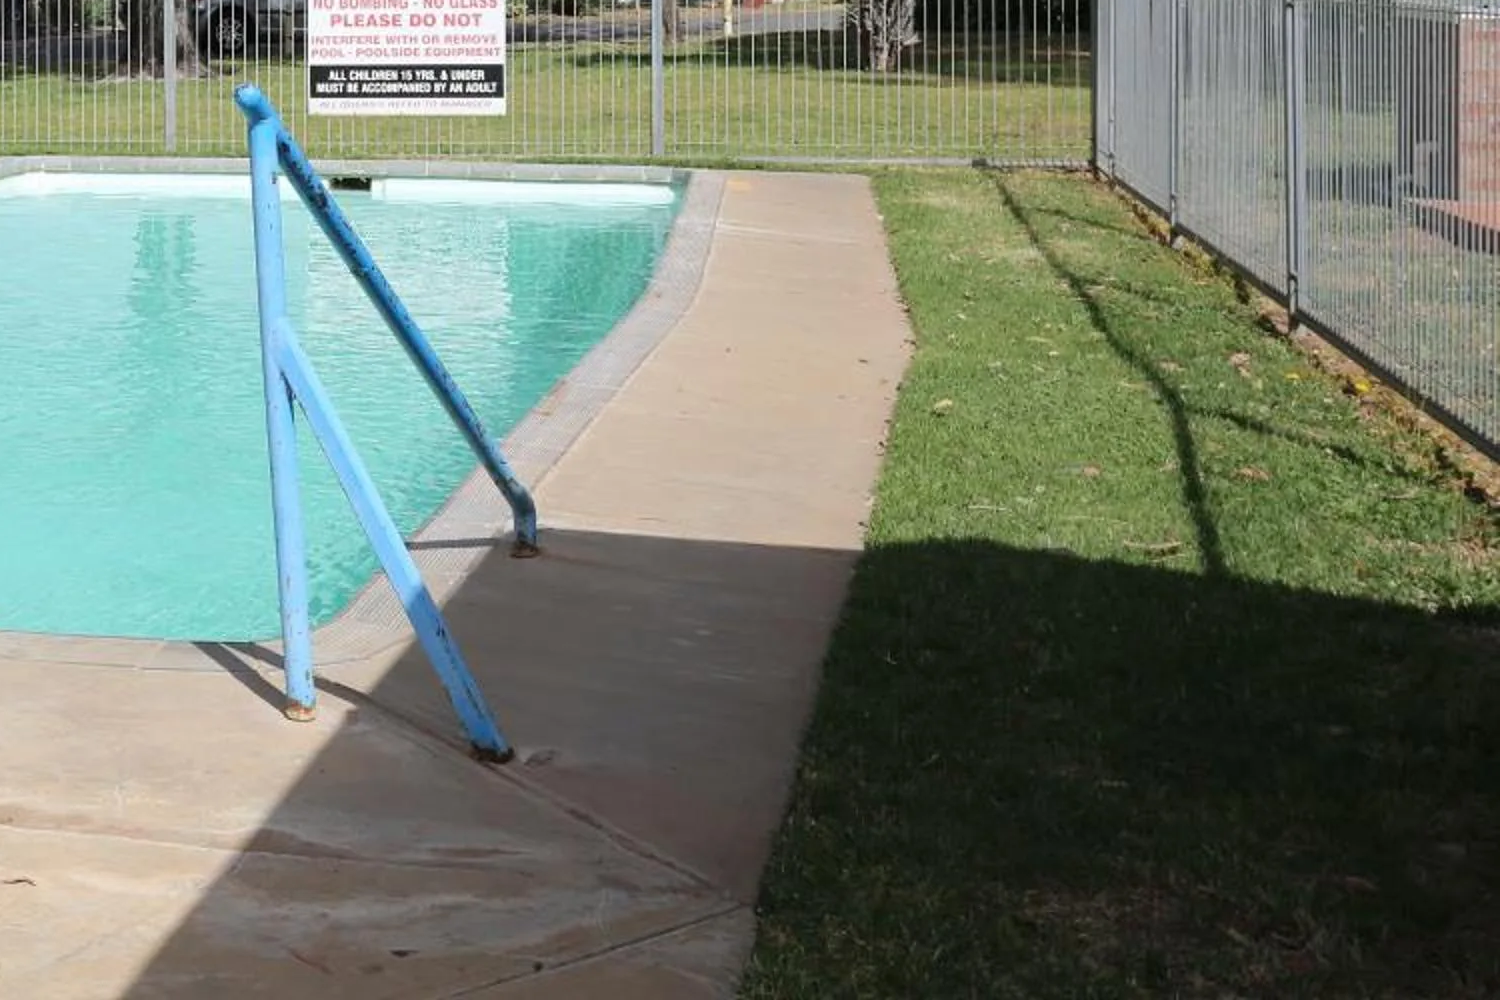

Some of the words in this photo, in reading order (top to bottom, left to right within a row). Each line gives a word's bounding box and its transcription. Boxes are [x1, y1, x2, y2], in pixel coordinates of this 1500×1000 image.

[330, 14, 402, 27] PLEASE
[409, 14, 436, 27] DO
[443, 14, 483, 27] NOT
[312, 35, 380, 45] INTERFERE
[385, 35, 418, 45] WITH
[422, 35, 439, 45] OR
[445, 34, 498, 45] REMOVE
[311, 48, 344, 58] POOL
[355, 48, 420, 57] POOLSIDE
[425, 47, 501, 57] EQUIPMENT
[328, 71, 347, 80] ALL
[349, 70, 398, 80] CHILDREN
[451, 70, 485, 80] UNDER
[316, 83, 344, 93] MUST
[347, 83, 358, 93] BE
[361, 83, 431, 93] ACCOMPANIED
[434, 82, 446, 92] BY
[449, 83, 462, 92] AN
[465, 82, 497, 92] ADULT
